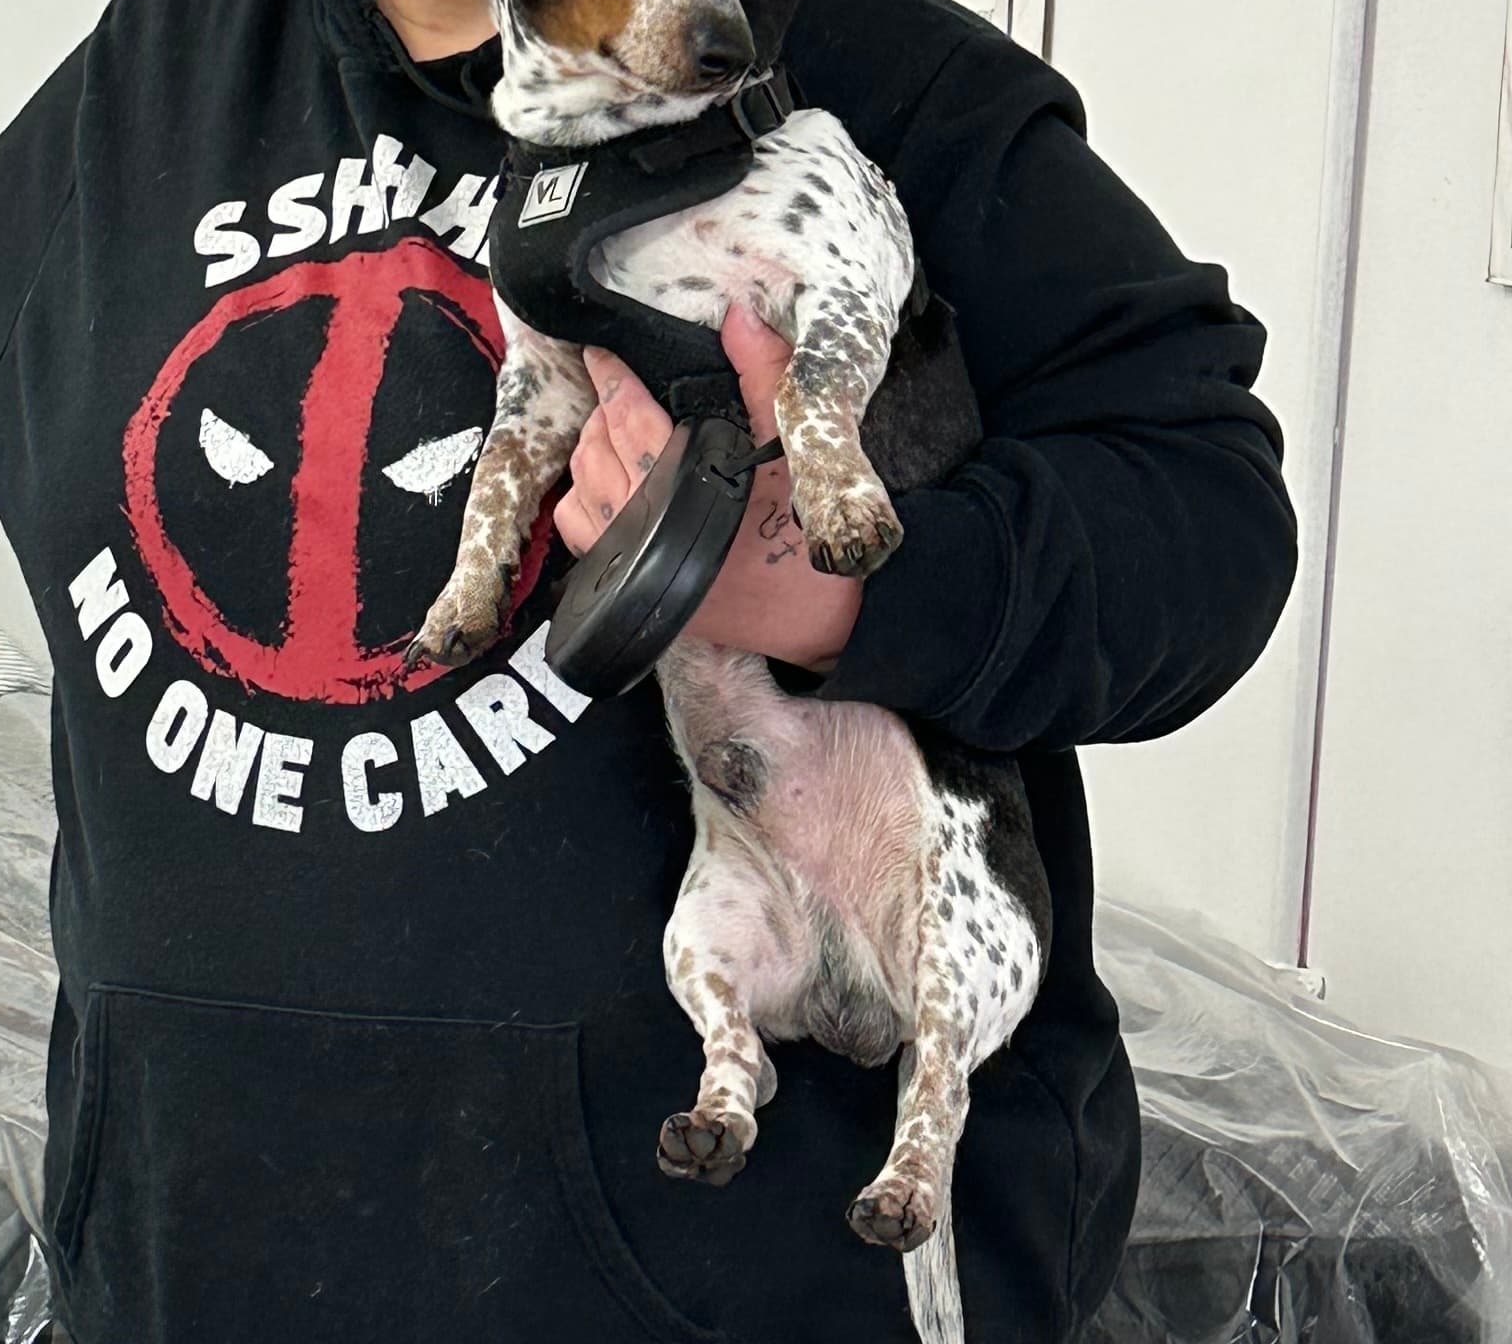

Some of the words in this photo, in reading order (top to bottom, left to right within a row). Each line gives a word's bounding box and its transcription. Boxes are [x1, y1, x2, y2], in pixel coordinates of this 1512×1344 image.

[194, 134, 501, 288] SSHHH
[68, 546, 153, 698] NO
[145, 679, 314, 833] ONE
